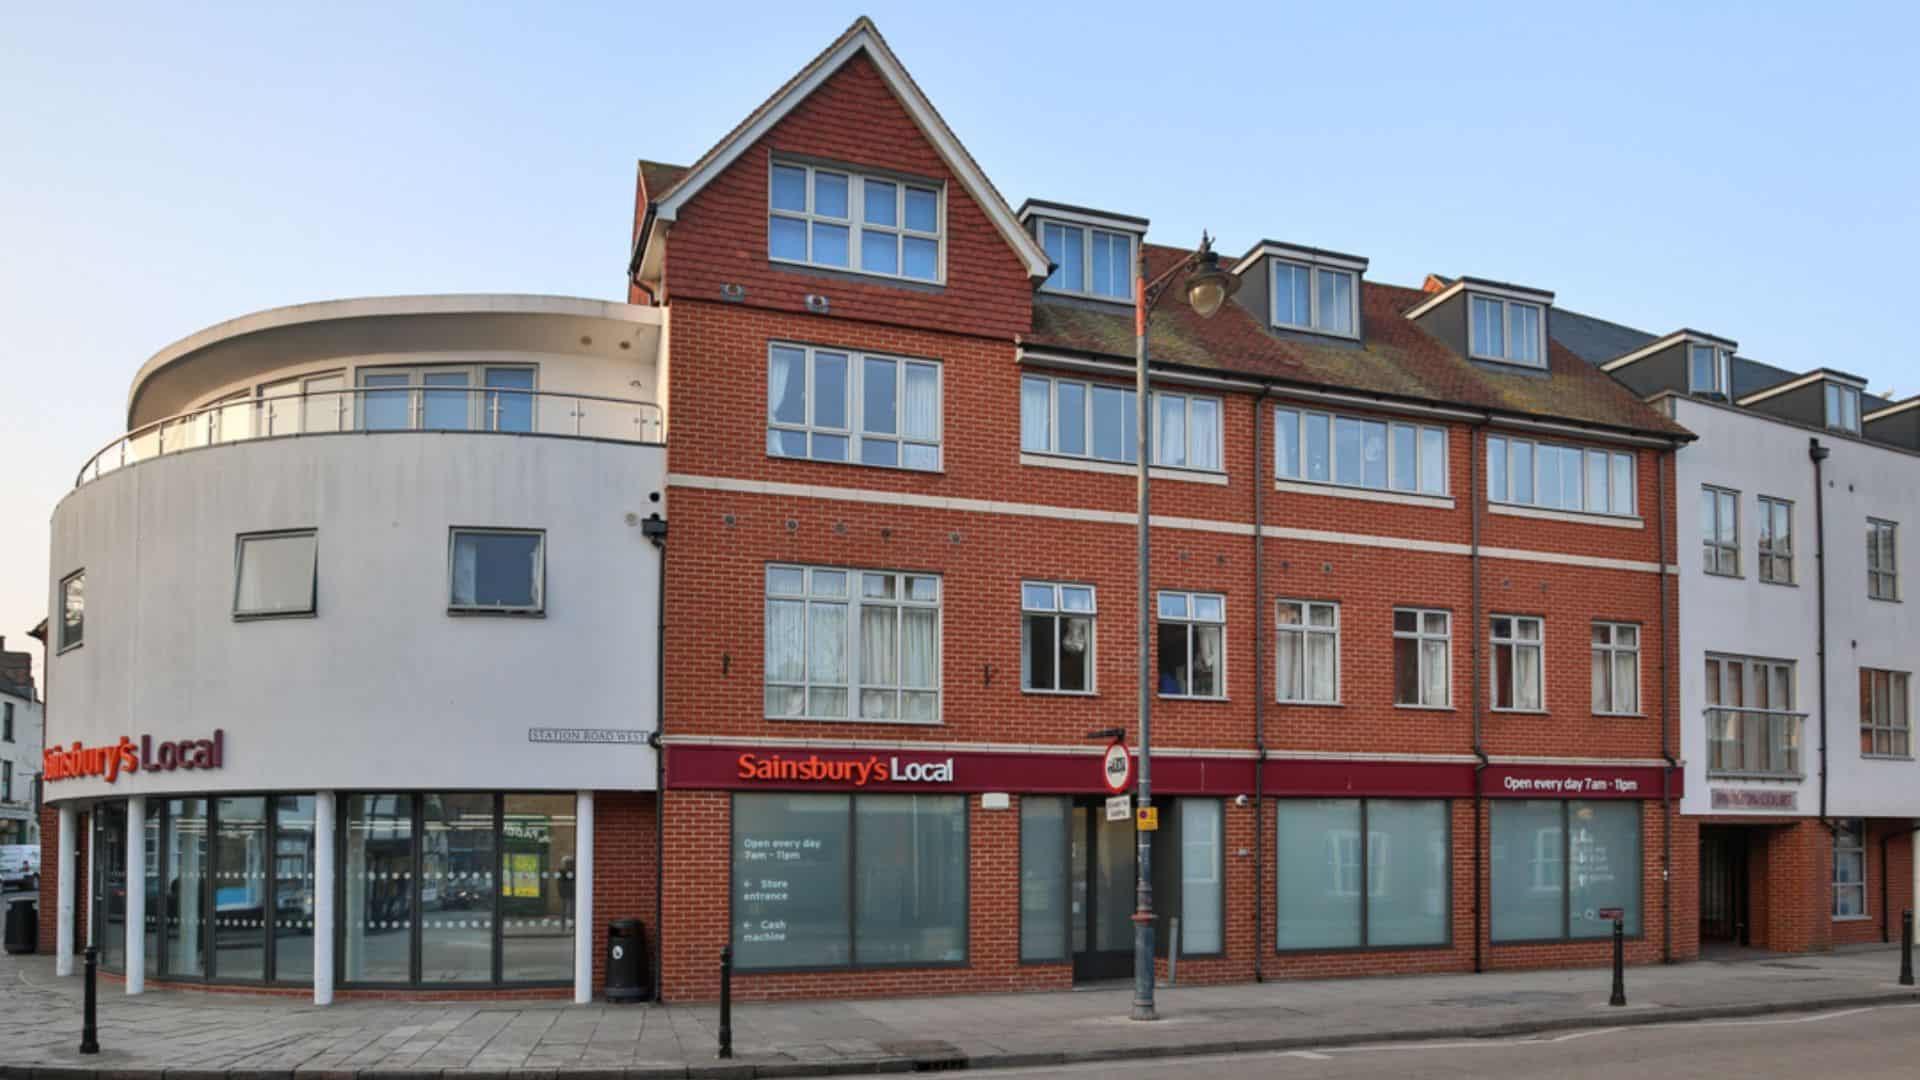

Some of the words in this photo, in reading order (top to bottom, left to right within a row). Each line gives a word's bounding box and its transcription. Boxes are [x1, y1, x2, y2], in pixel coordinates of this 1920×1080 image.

[532, 729, 580, 740] STATION
[583, 730, 615, 741] ROAD
[616, 731, 645, 741] WEST
[141, 729, 224, 773] Local
[738, 753, 888, 785] Sainsbury's
[891, 757, 953, 781] Local
[1504, 776, 1532, 792] Open
[1534, 779, 1562, 792] every
[1564, 778, 1583, 792] day
[1584, 778, 1607, 790] 7am
[1615, 779, 1638, 792] 11pm
[744, 839, 770, 850] Open
[772, 839, 801, 850] every
[803, 839, 821, 850] day
[744, 850, 767, 860] 7am
[777, 850, 801, 861] 11pm
[761, 880, 788, 889] Store
[743, 892, 788, 901] entrance
[761, 919, 786, 929] Cash
[743, 931, 786, 941] machine
